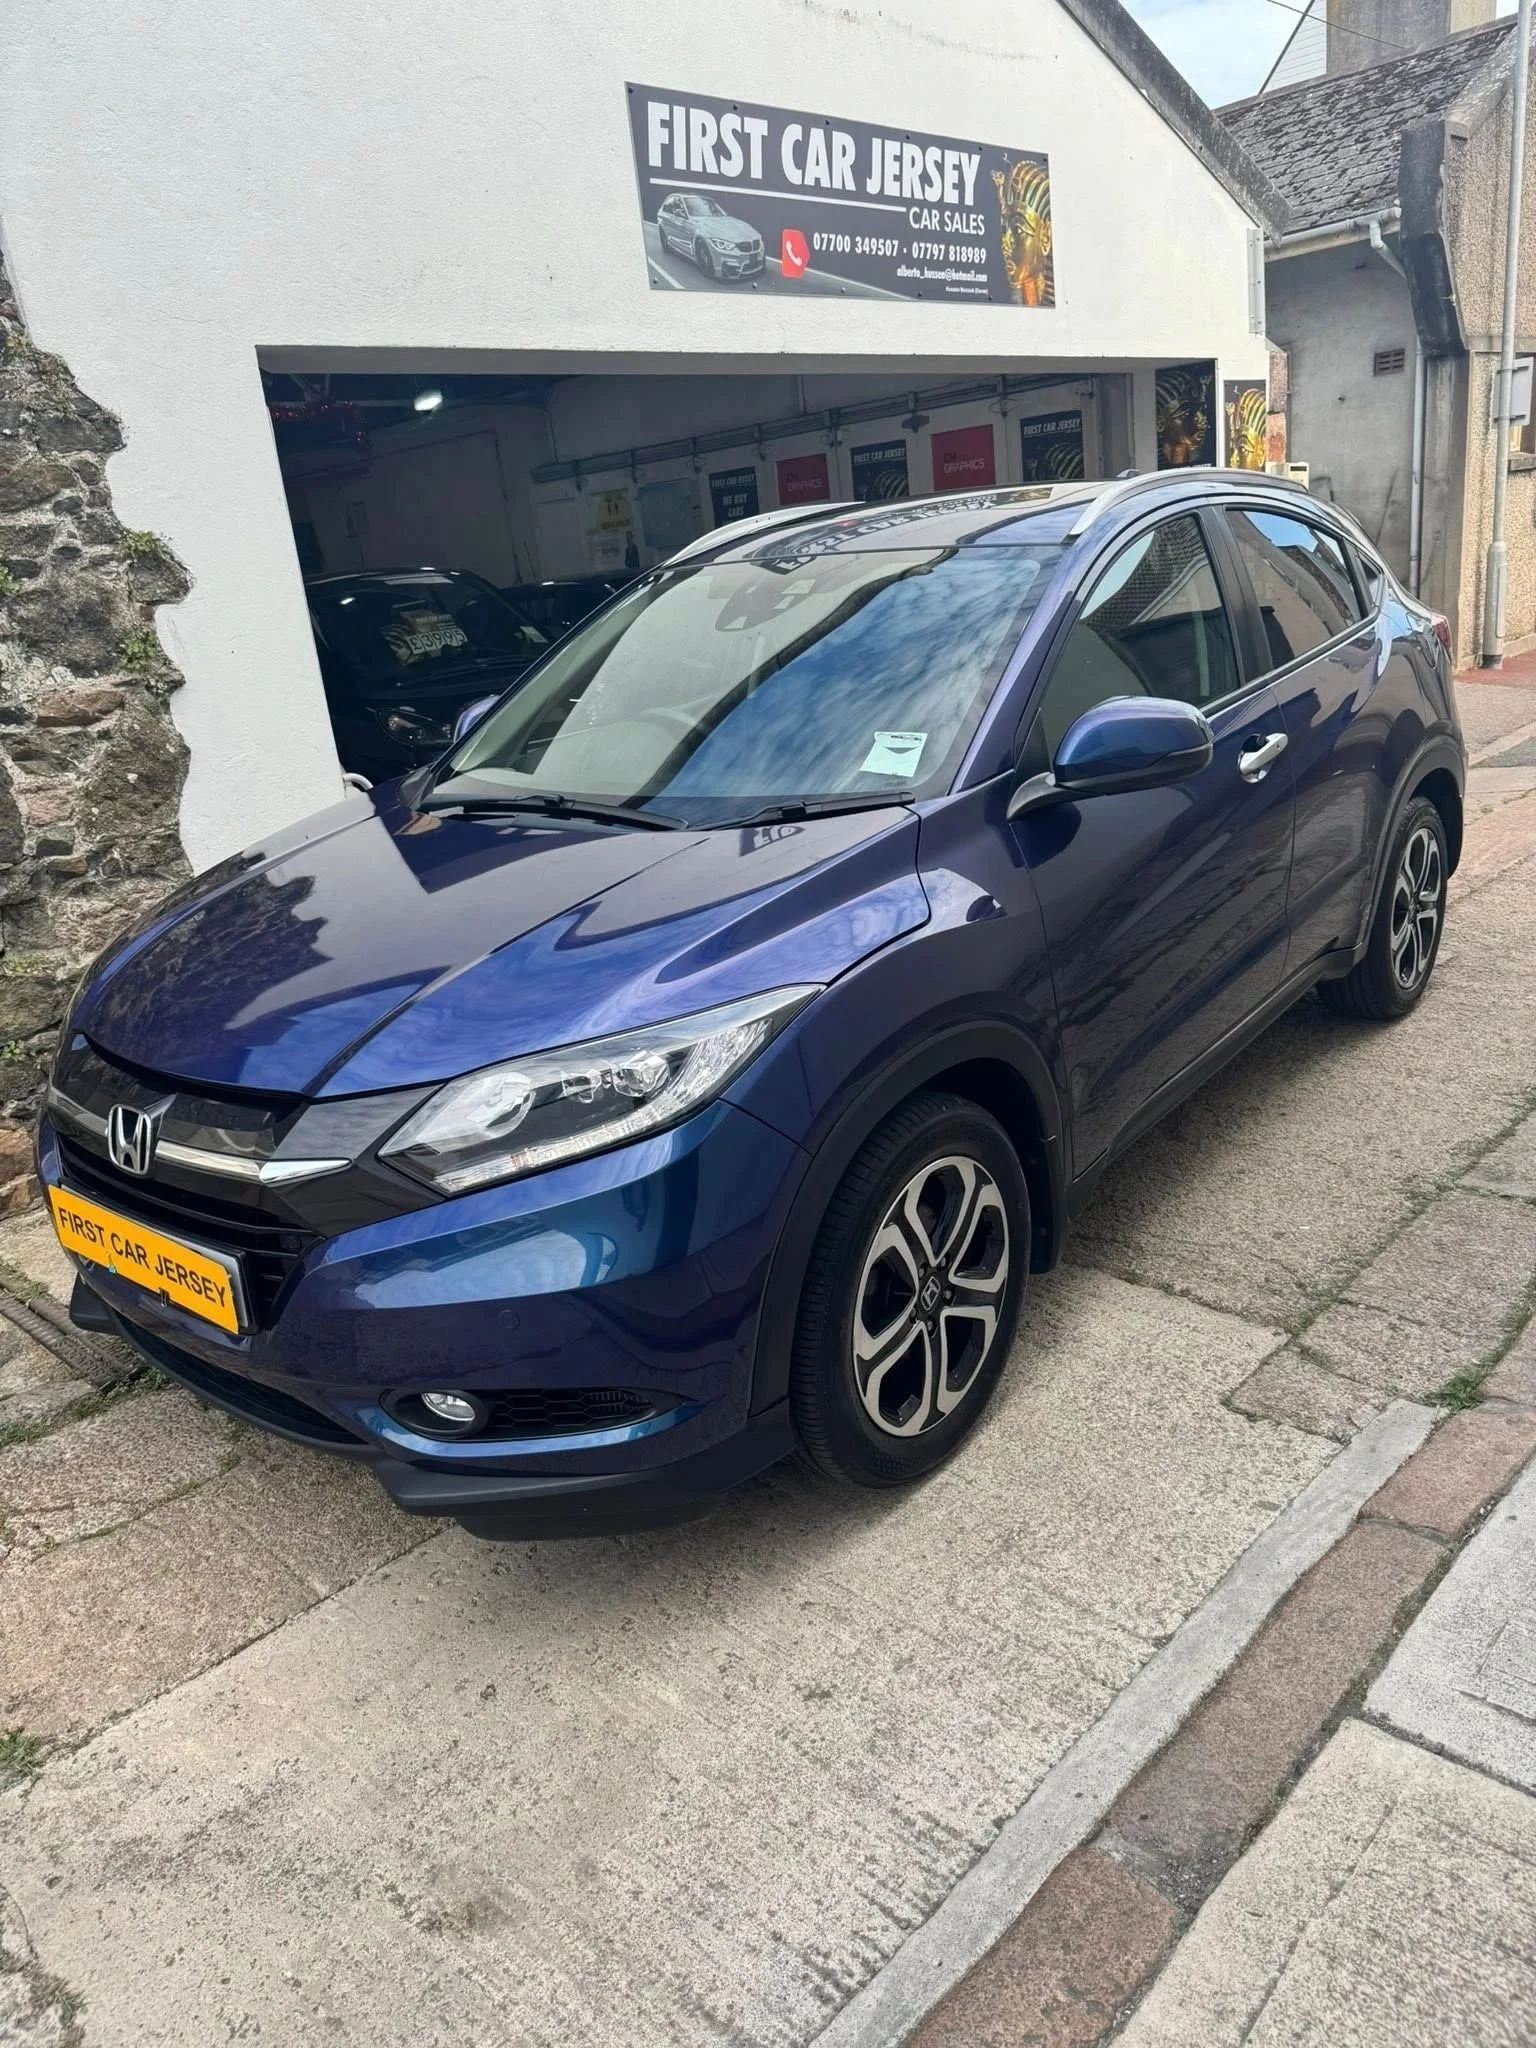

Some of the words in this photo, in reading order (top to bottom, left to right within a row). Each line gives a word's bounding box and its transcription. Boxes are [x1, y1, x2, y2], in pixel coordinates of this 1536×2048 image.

[647, 101, 768, 179] FIRST
[781, 123, 856, 191] CAR
[866, 137, 981, 206] JERSEY
[909, 206, 940, 231] CAR
[944, 211, 985, 236] SALES
[813, 232, 851, 253] 07700
[855, 236, 899, 257] 349507
[912, 241, 946, 261] 07797
[948, 245, 987, 265] 818989
[1023, 423, 1042, 436] FIRST
[1043, 421, 1057, 432] CAR
[1057, 418, 1081, 430] JERSEY
[944, 458, 985, 474] GRAPHICS
[410, 629, 465, 651] £3995
[58, 1207, 105, 1247] FIRST
[110, 1232, 150, 1270] CAR
[155, 1254, 226, 1307] JERSEY
